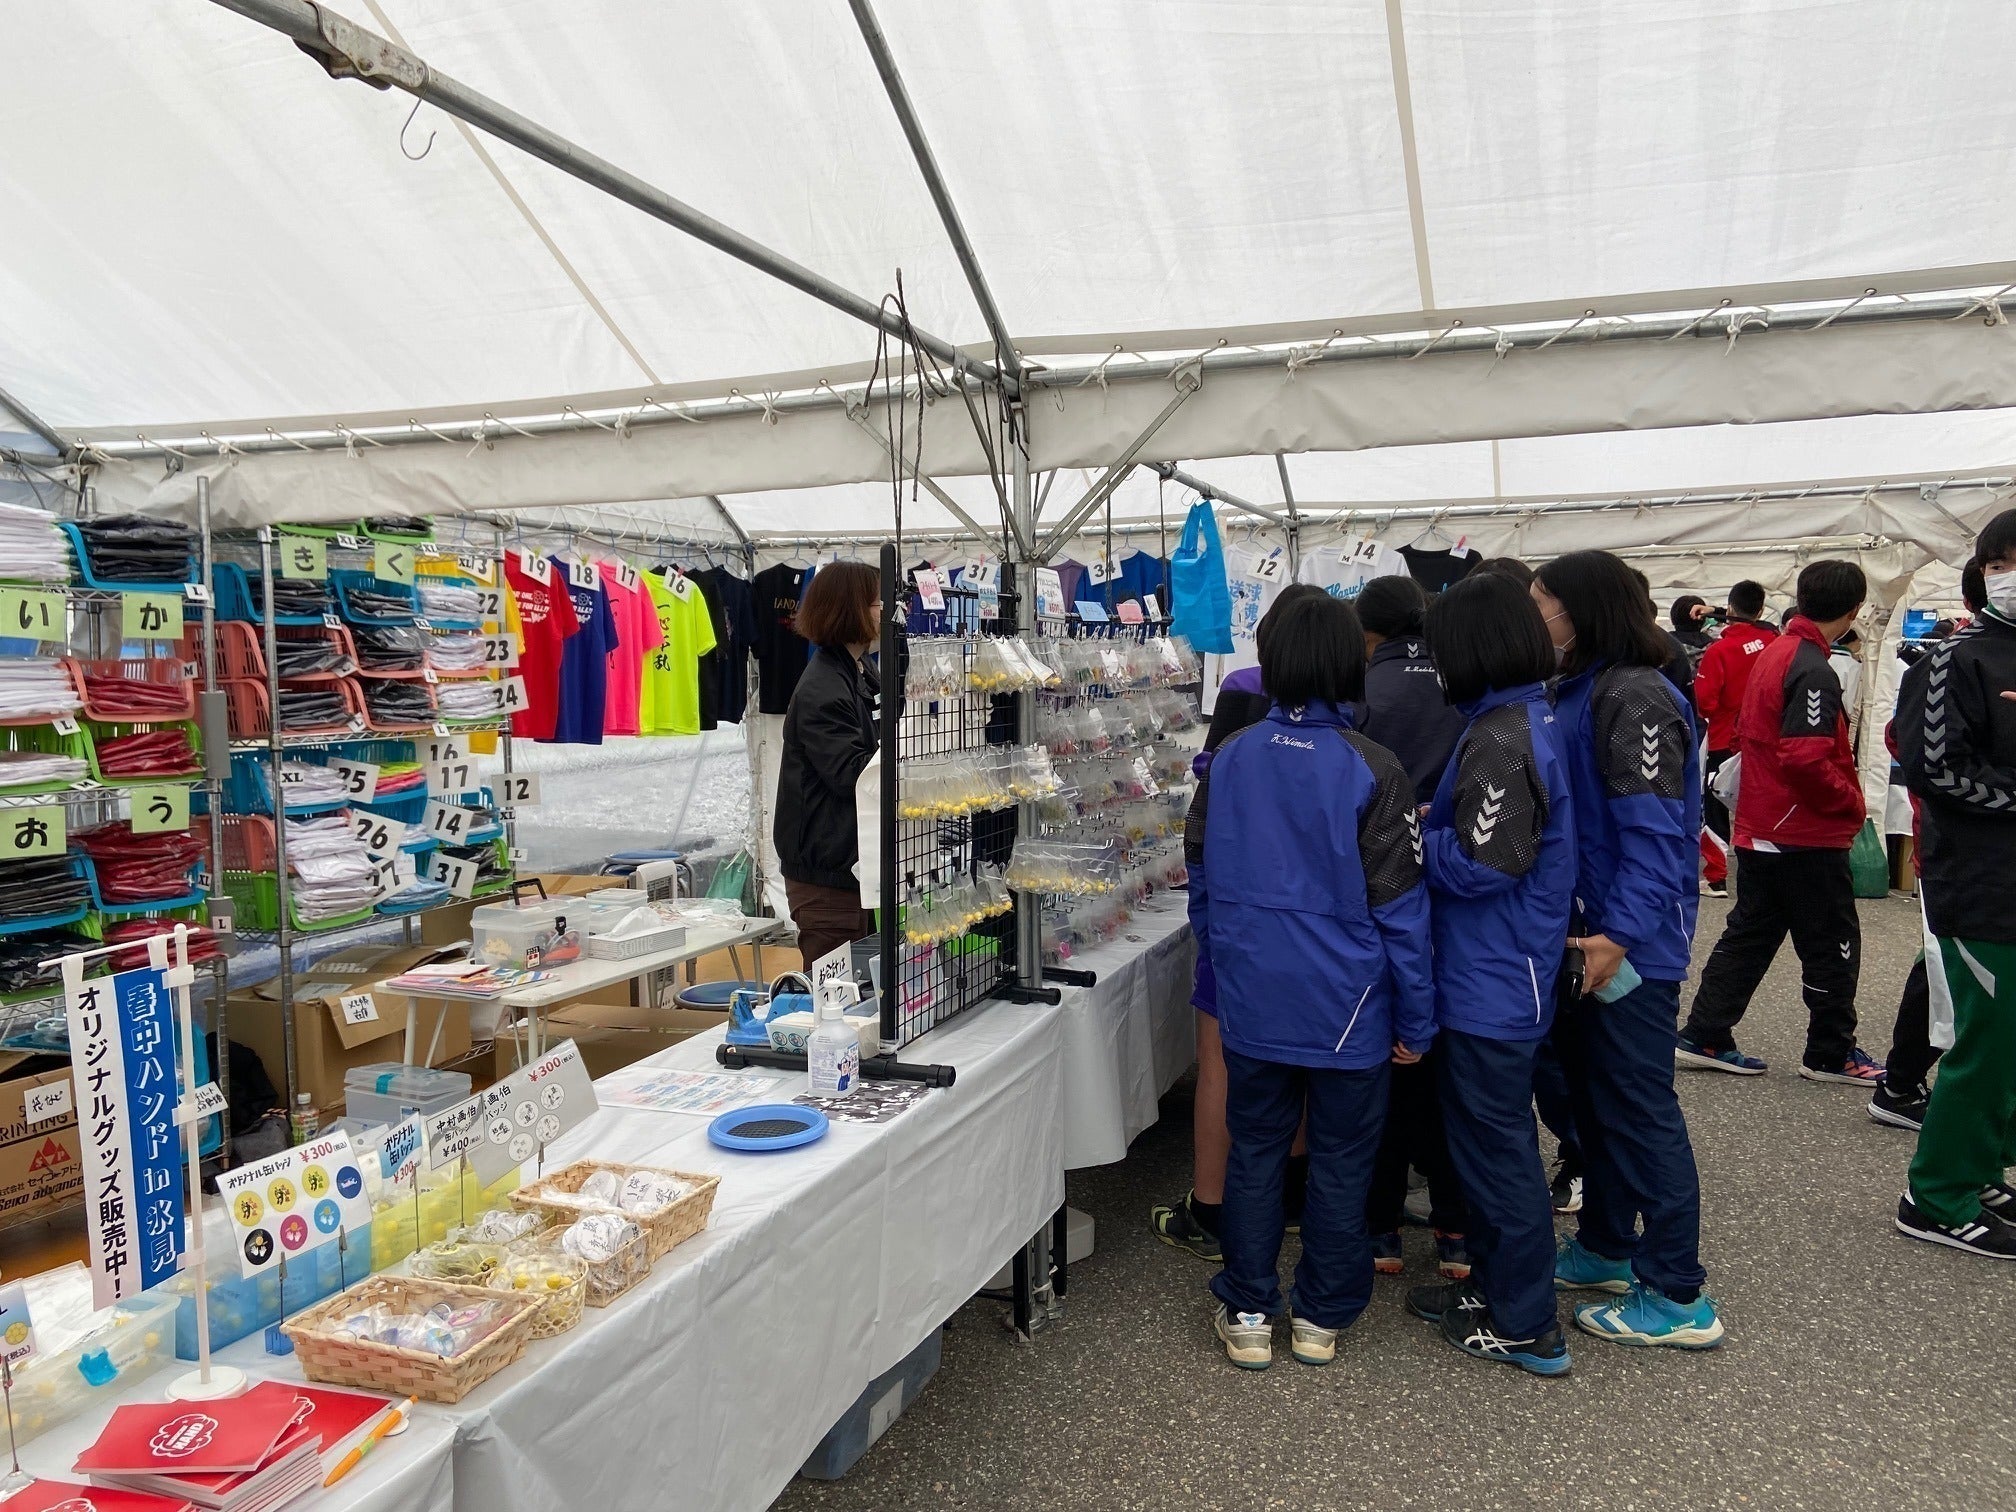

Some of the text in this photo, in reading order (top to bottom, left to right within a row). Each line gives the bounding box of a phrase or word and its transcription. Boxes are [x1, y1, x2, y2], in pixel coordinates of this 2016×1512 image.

[294, 546, 315, 572] き
[1354, 541, 1376, 560] 14
[387, 552, 403, 576] く
[528, 555, 546, 577] 19
[575, 564, 593, 585] 18
[968, 564, 988, 581] 31
[1256, 558, 1278, 577] 12
[620, 565, 636, 587] 17
[668, 573, 685, 594] 16
[192, 586, 201, 595] L
[19, 600, 49, 630] い
[140, 602, 168, 631] か
[485, 640, 510, 662] 23
[1742, 638, 1765, 655] EHC
[184, 665, 194, 677] M
[492, 684, 518, 709] 24
[62, 720, 72, 730] L
[430, 744, 459, 761] 16
[282, 772, 303, 783] XL
[338, 767, 367, 793] 25
[441, 764, 469, 789] 17
[504, 778, 530, 801] 12
[149, 796, 173, 824] う
[500, 811, 516, 820] XL
[14, 817, 48, 849] お
[434, 809, 463, 836] 14
[354, 818, 389, 850] 26
[514, 849, 522, 859] L
[199, 874, 209, 885] XL
[434, 862, 463, 888] 31
[218, 917, 226, 929] L
[528, 1056, 562, 1082] ¥300
[436, 1104, 477, 1132] 中村画伯
[298, 1141, 333, 1163] ¥300
[442, 1136, 469, 1158] ¥400
